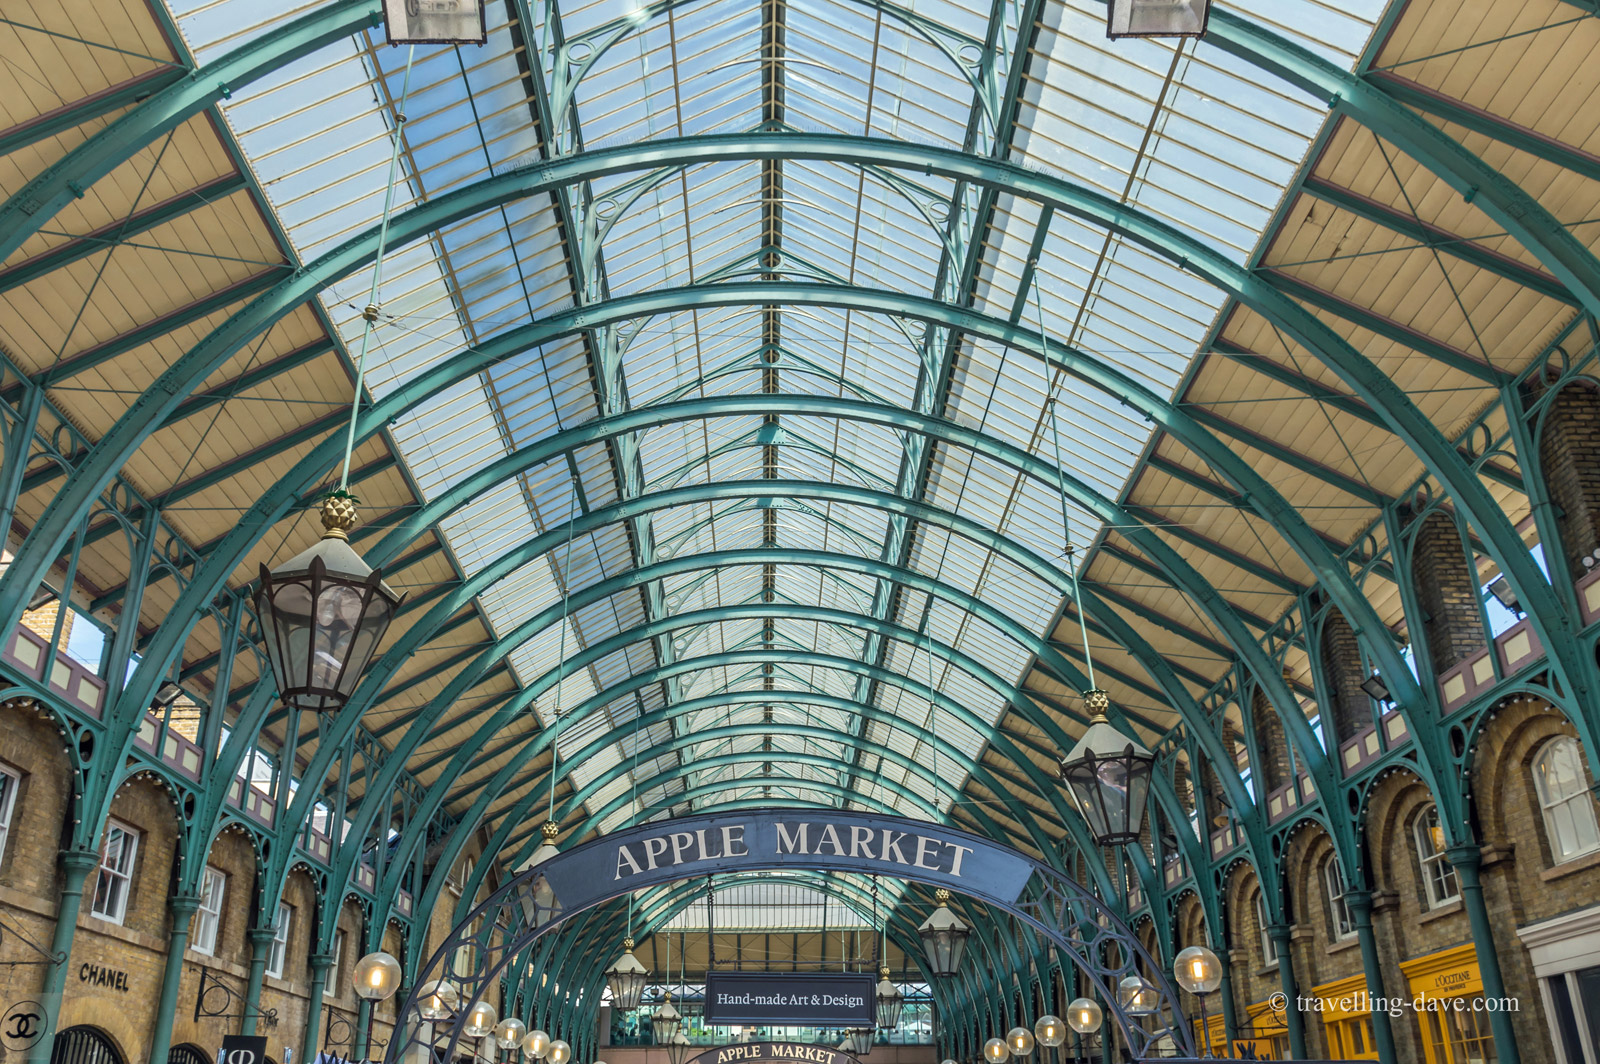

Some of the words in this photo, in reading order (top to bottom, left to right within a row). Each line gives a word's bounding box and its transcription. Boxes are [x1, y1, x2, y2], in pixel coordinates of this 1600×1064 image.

[614, 825, 749, 881] APPLE
[773, 822, 974, 877] MARKET
[79, 963, 129, 992] CHANEL
[717, 993, 787, 1005] Hand-made
[789, 994, 809, 1006] Art
[811, 994, 820, 1006] &
[822, 994, 864, 1008] Design
[717, 1045, 762, 1064] APPLE
[771, 1044, 836, 1064] MARKET
